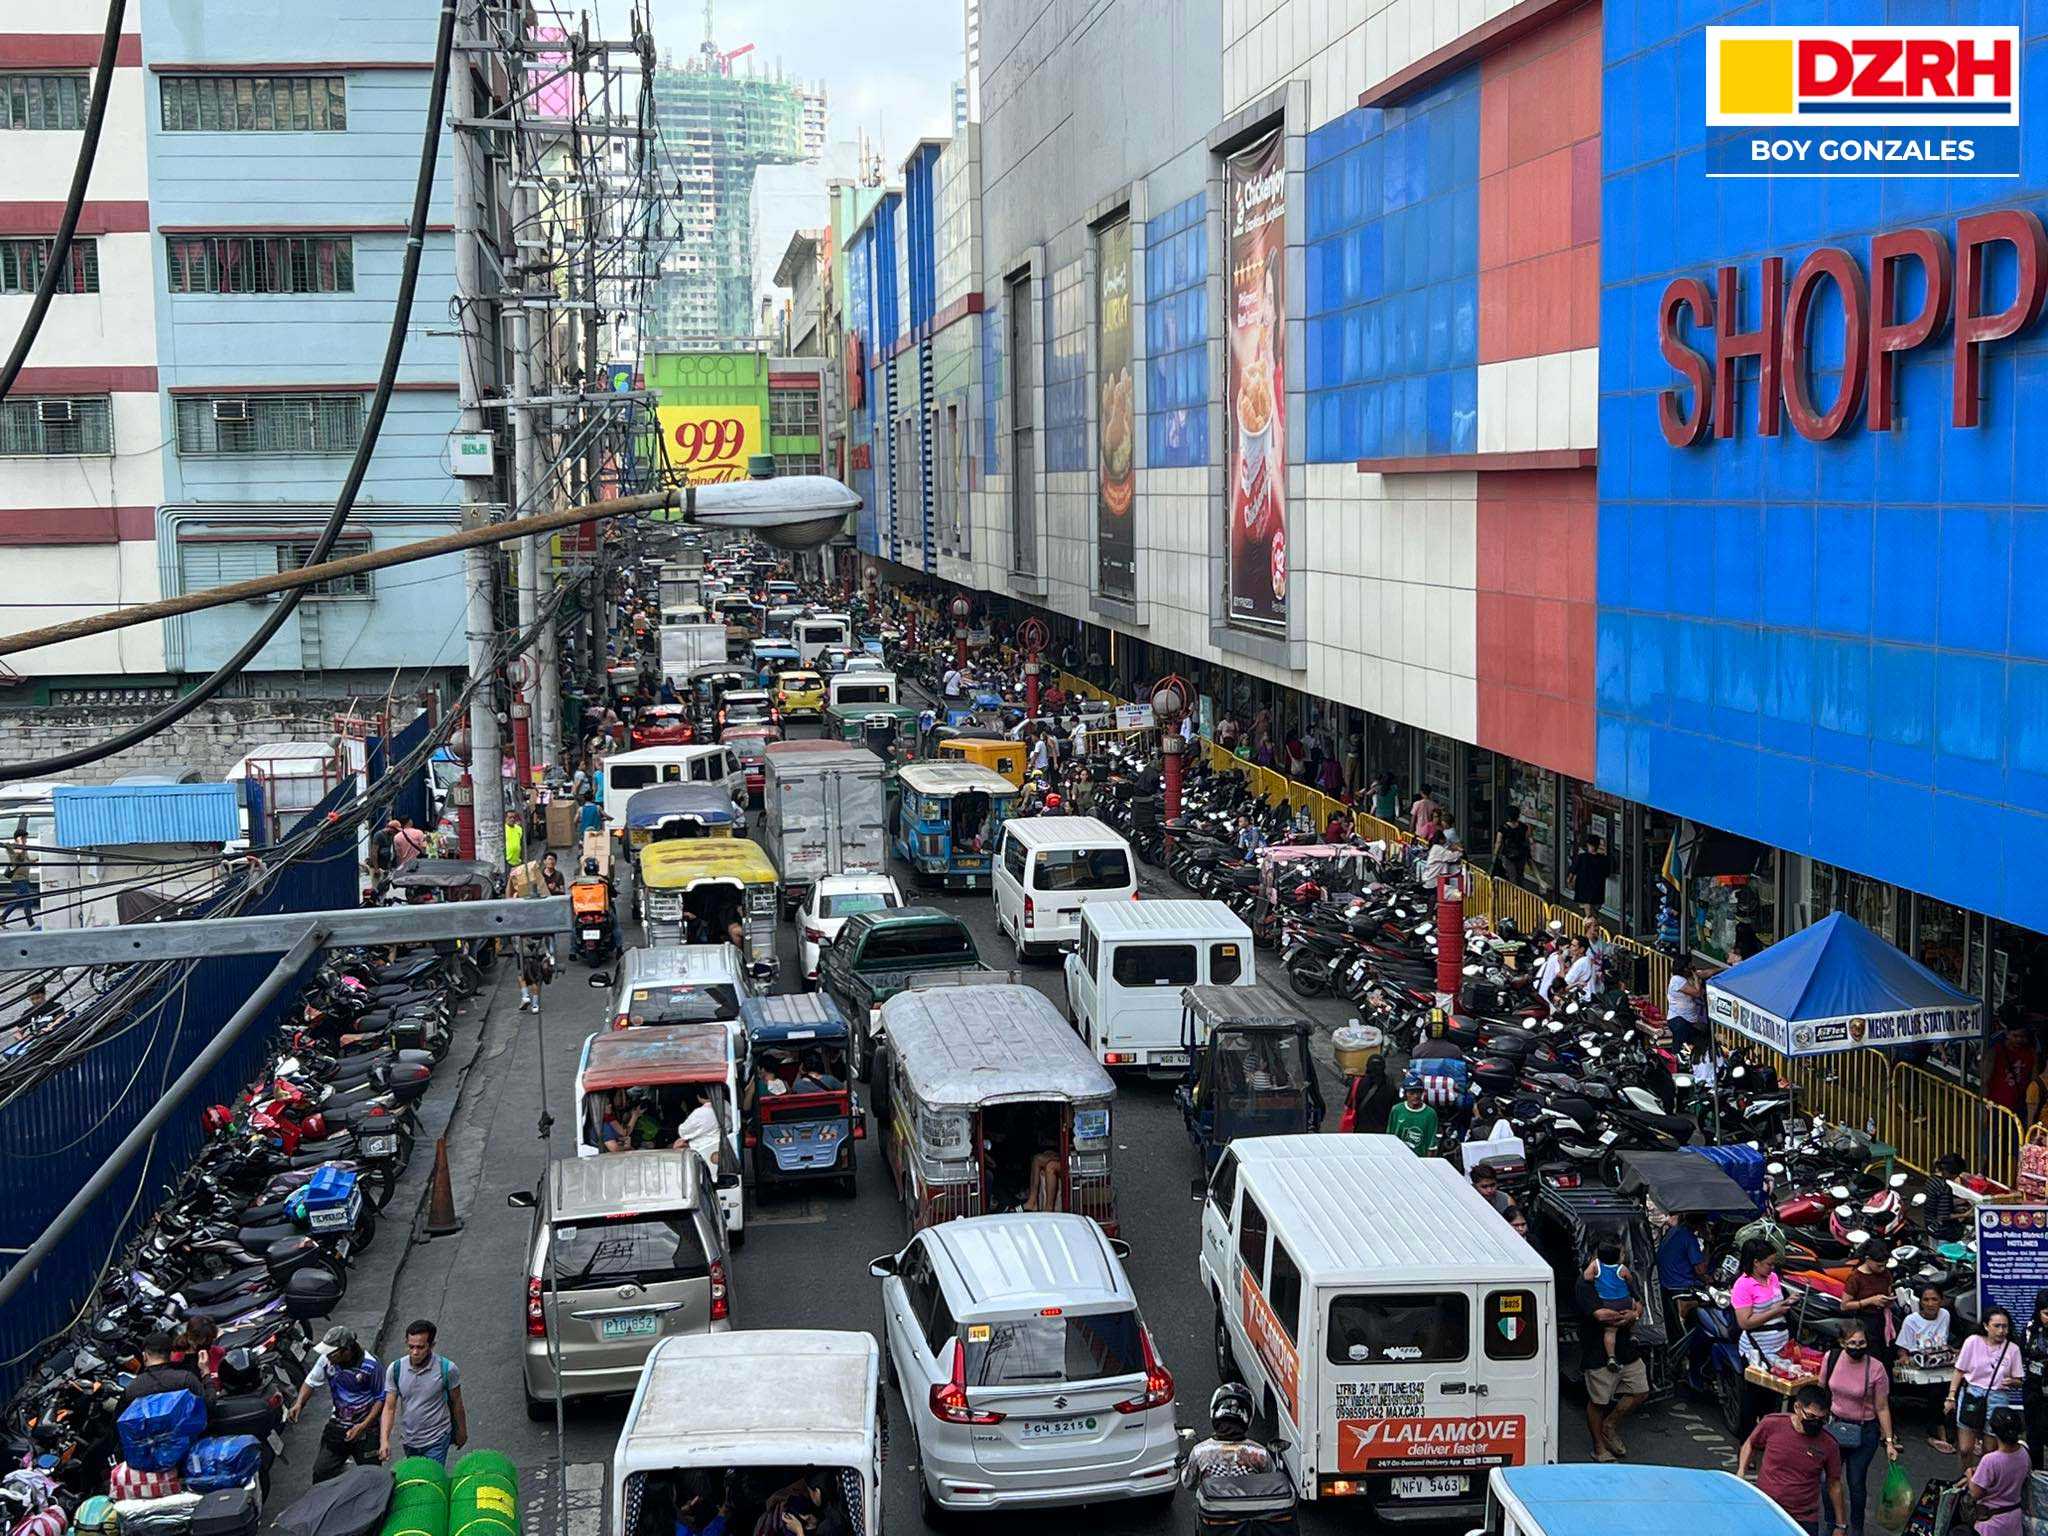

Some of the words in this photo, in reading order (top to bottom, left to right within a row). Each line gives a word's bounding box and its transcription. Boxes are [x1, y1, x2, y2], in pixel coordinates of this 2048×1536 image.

[1658, 209, 2048, 449] SHOPP
[674, 418, 745, 466] 999
[1868, 1016, 1895, 1040] MEISIC
[1897, 1013, 1921, 1037] POLICE
[1924, 1008, 1955, 1034] STATION
[1382, 1420, 1519, 1443] LALAMOVE
[1407, 1443, 1451, 1456] deliver
[1453, 1441, 1489, 1455] faster
[1402, 1480, 1423, 1493] NFV
[1430, 1478, 1458, 1492] 5463
